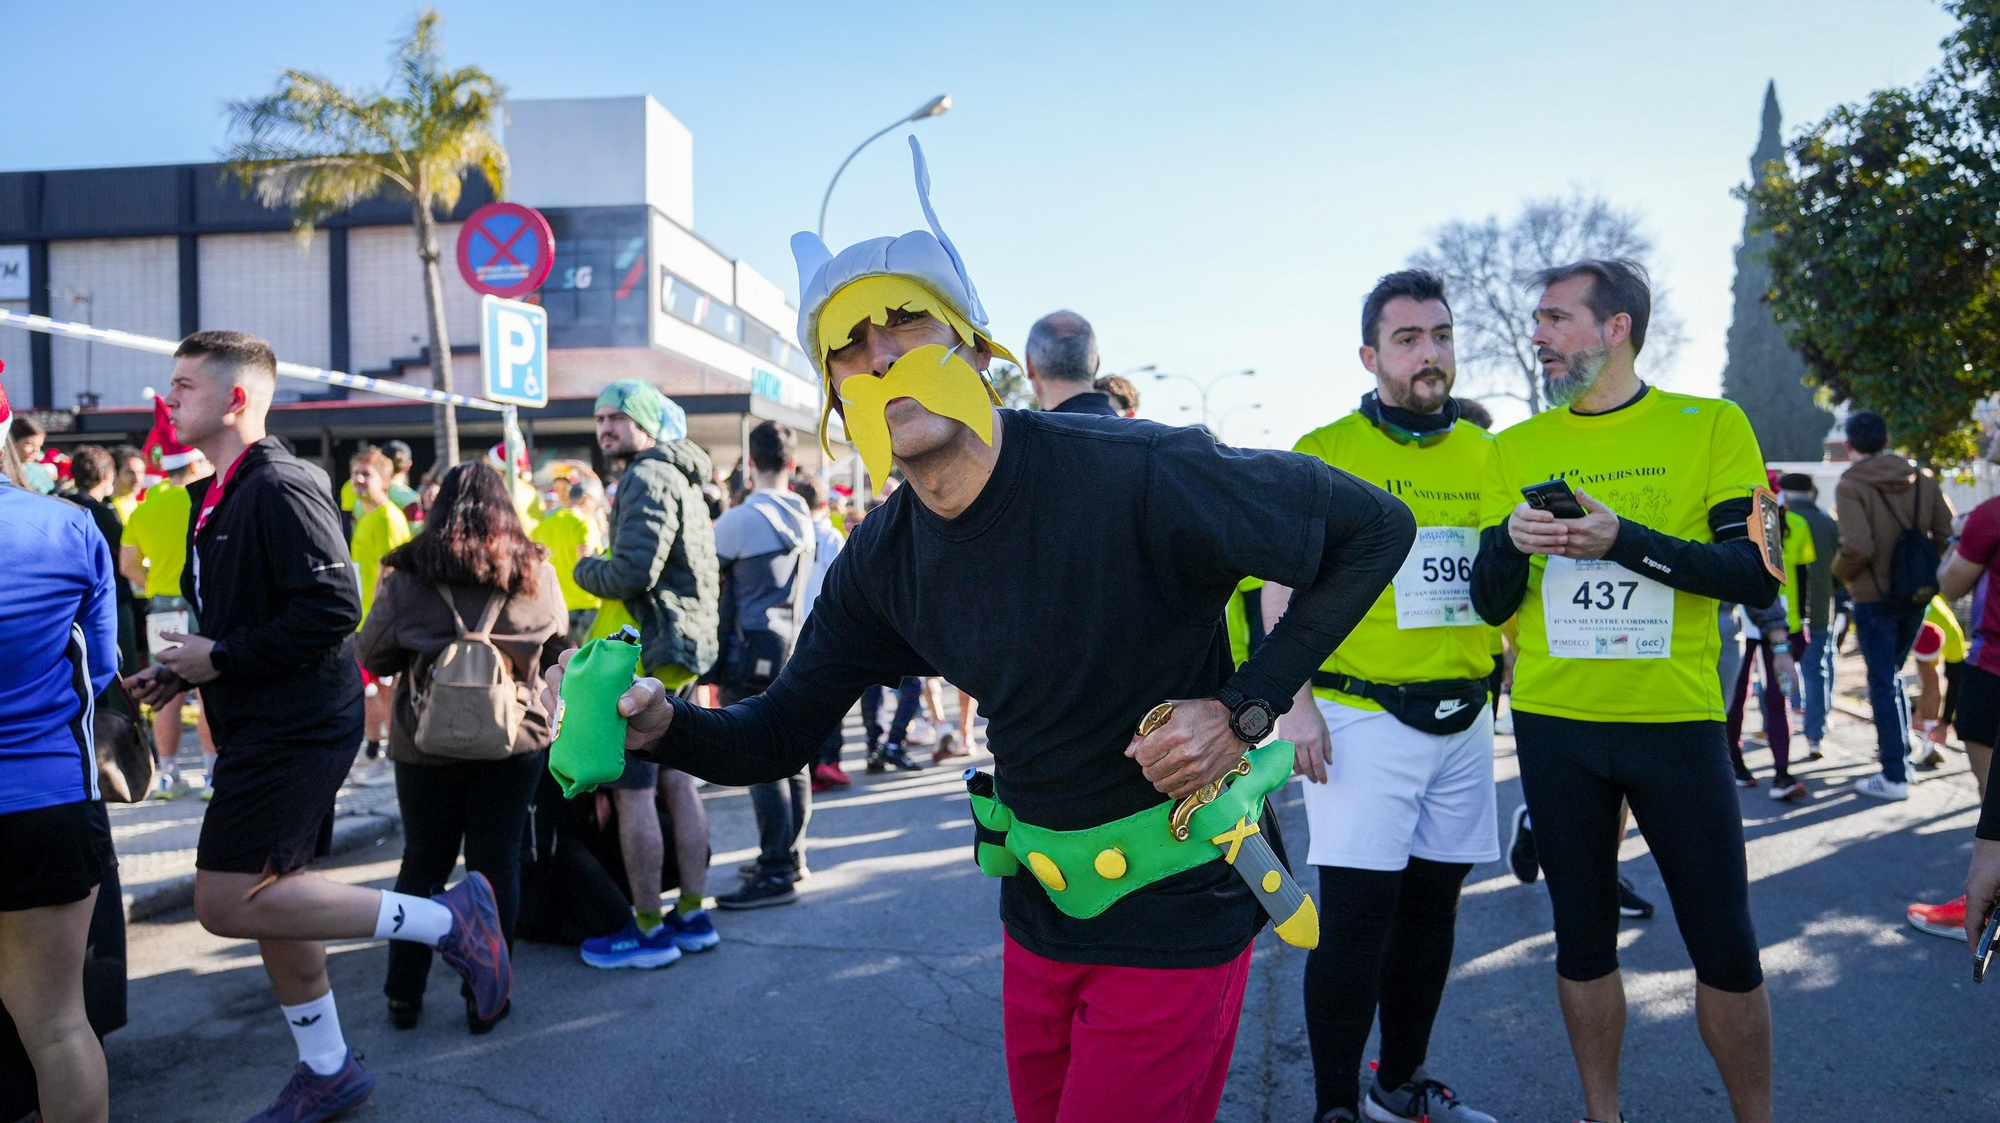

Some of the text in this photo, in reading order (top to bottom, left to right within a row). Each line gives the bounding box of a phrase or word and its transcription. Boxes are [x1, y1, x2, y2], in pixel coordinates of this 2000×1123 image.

[563, 266, 593, 289] SG
[497, 309, 536, 389] P
[1577, 467, 1667, 485] ANIVERSARIO
[1422, 556, 1472, 583] 596
[1642, 555, 1671, 574] kipsta
[1572, 581, 1639, 610] 437
[1558, 639, 1590, 647] IMDECO
[1440, 699, 1461, 710] NIKE
